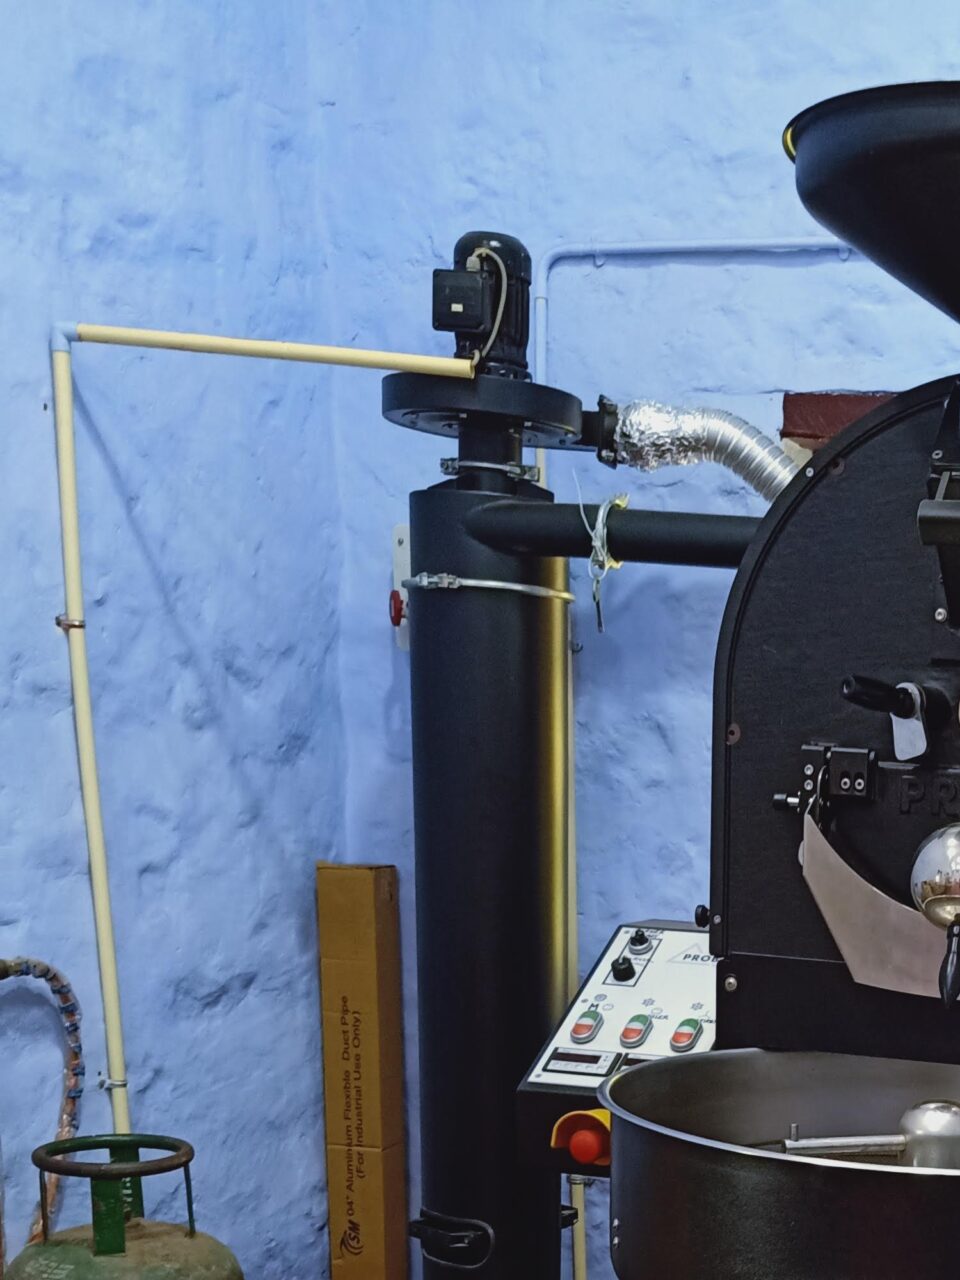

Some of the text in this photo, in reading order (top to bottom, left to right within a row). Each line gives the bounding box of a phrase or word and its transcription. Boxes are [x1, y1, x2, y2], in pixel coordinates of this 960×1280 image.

[341, 995, 350, 1026] Pipe
[342, 1029, 350, 1061] Duct
[343, 1070, 351, 1120] Flexible
[352, 1010, 366, 1179] (For Industrial Use Only)
